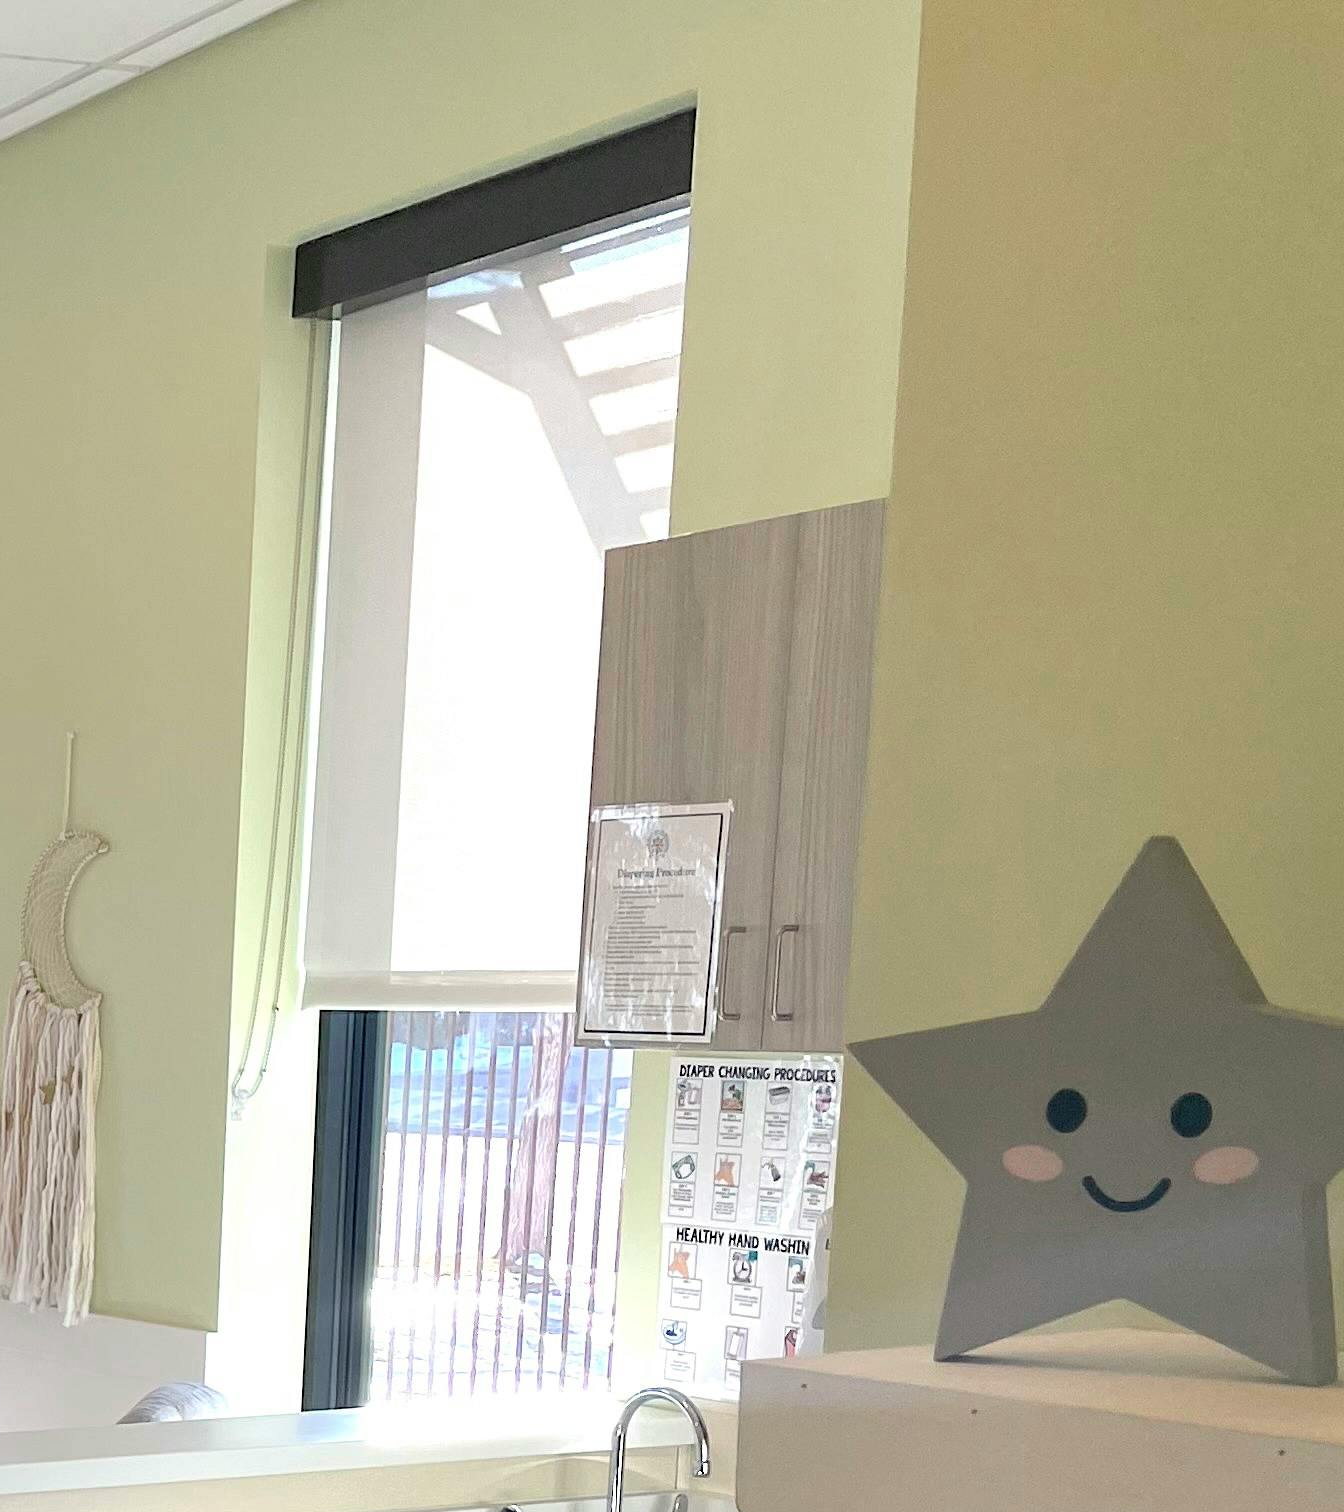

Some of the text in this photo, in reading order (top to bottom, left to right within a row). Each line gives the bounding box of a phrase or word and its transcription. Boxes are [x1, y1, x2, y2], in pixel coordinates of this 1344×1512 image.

[679, 1064, 837, 1084] DIAPER CHANGING PROCEDURES
[676, 1227, 810, 1256] HEALTHY HAND WASHIN
